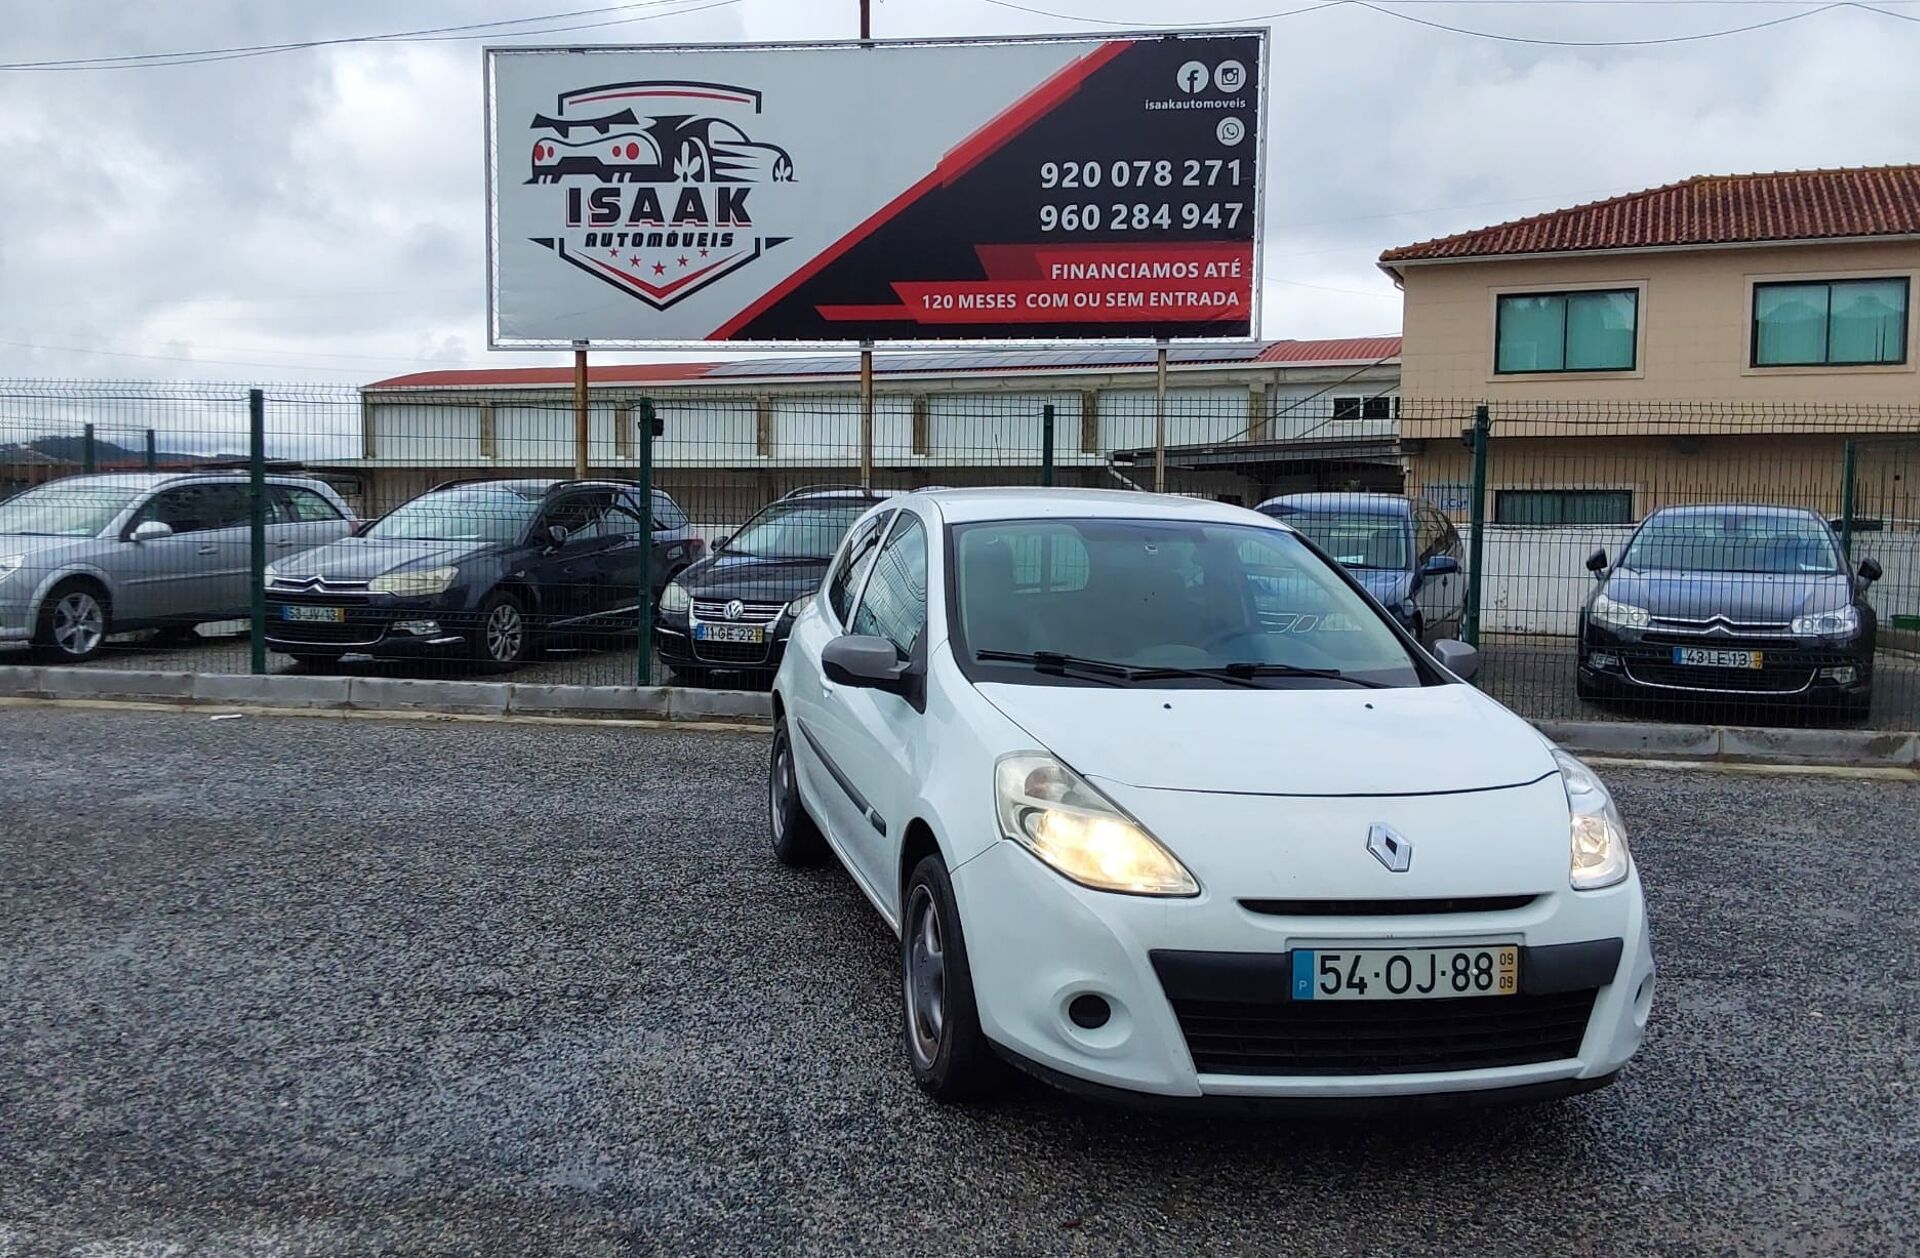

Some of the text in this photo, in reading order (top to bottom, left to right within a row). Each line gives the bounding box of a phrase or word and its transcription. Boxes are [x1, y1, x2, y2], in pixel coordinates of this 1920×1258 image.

[1145, 98, 1246, 110] isaakautomoveis
[1040, 159, 1242, 189] 920 078 271
[566, 186, 752, 227] ISAAK
[1039, 202, 1244, 231] 960 284 947
[585, 230, 734, 248] AUTOMÓVEIS
[1051, 257, 1242, 280] FINANCIAMOS ATÉ
[922, 291, 1240, 309] 120 MESES COM OU SEM ENTRADA
[1499, 953, 1514, 966] 09
[1299, 980, 1307, 990] P
[1499, 976, 1514, 989] 09
